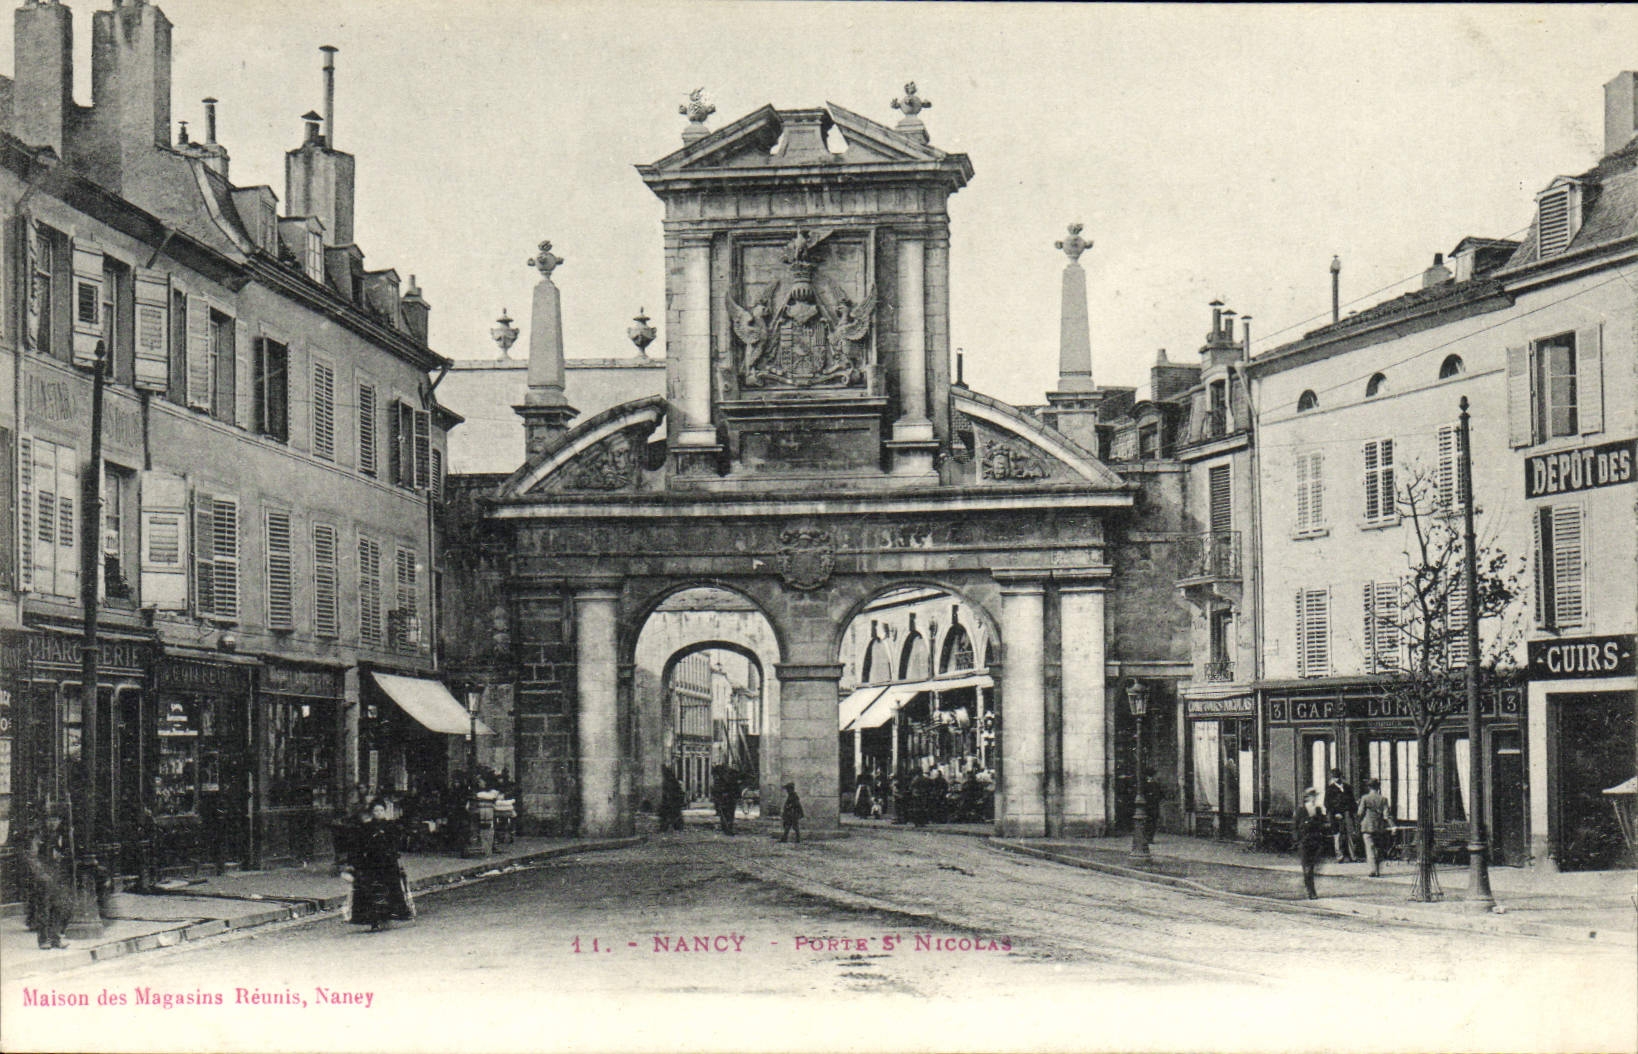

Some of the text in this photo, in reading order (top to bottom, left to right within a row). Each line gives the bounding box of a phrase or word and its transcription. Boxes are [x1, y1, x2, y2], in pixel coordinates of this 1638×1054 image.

[1597, 449, 1630, 485] DES
[28, 637, 139, 667] CHARCERIE
[1547, 641, 1618, 673] CUIRS
[1273, 703, 1281, 719] 3
[1506, 695, 1517, 712] 3
